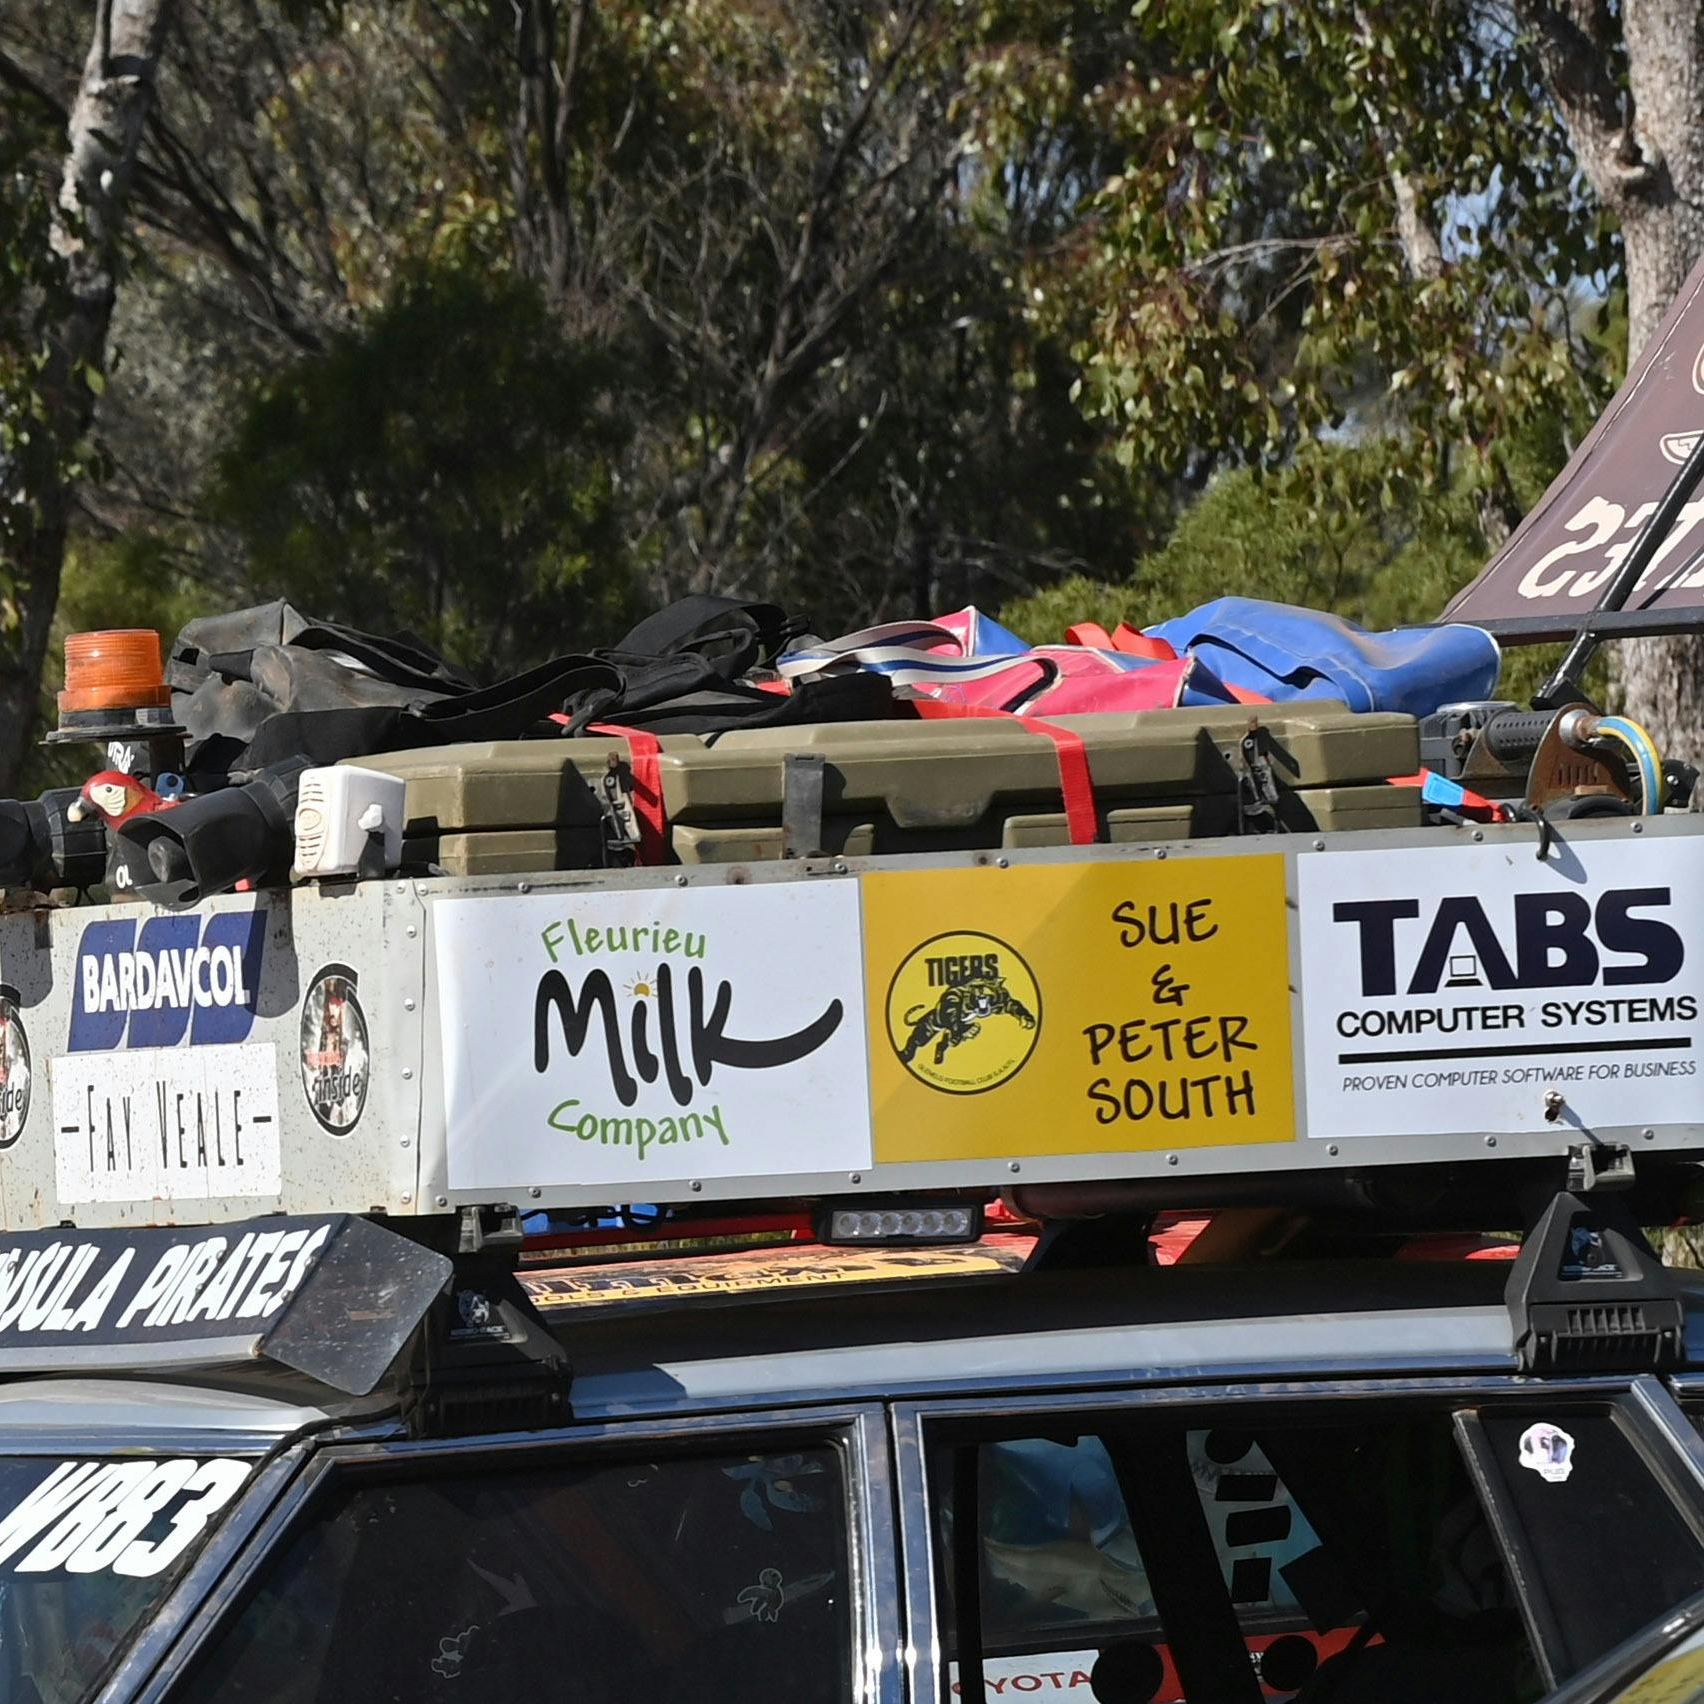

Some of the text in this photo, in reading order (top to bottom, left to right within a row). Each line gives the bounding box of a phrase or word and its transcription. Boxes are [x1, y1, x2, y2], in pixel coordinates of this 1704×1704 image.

[541, 919, 706, 963] Fleurieu
[1110, 897, 1219, 949] SUE
[1333, 887, 1685, 999] TABS
[82, 945, 251, 1013] BARDAVCOL
[925, 953, 999, 987] TIGERS
[1151, 965, 1191, 1007] &
[534, 962, 843, 1107] Milk
[1082, 1014, 1259, 1069] PETER
[1336, 996, 1698, 1040] COMPUTER SYSTEMS
[1086, 1068, 1258, 1126] SOUTH
[1343, 1060, 1697, 1092] PROVEN COMPUTER SOFTWARE FOR BUSINESS
[85, 1079, 245, 1172] FAY VEALE
[546, 1099, 730, 1159] Company
[119, 1223, 333, 1328] PIRATES
[657, 1272, 846, 1292] EQUIPMENT
